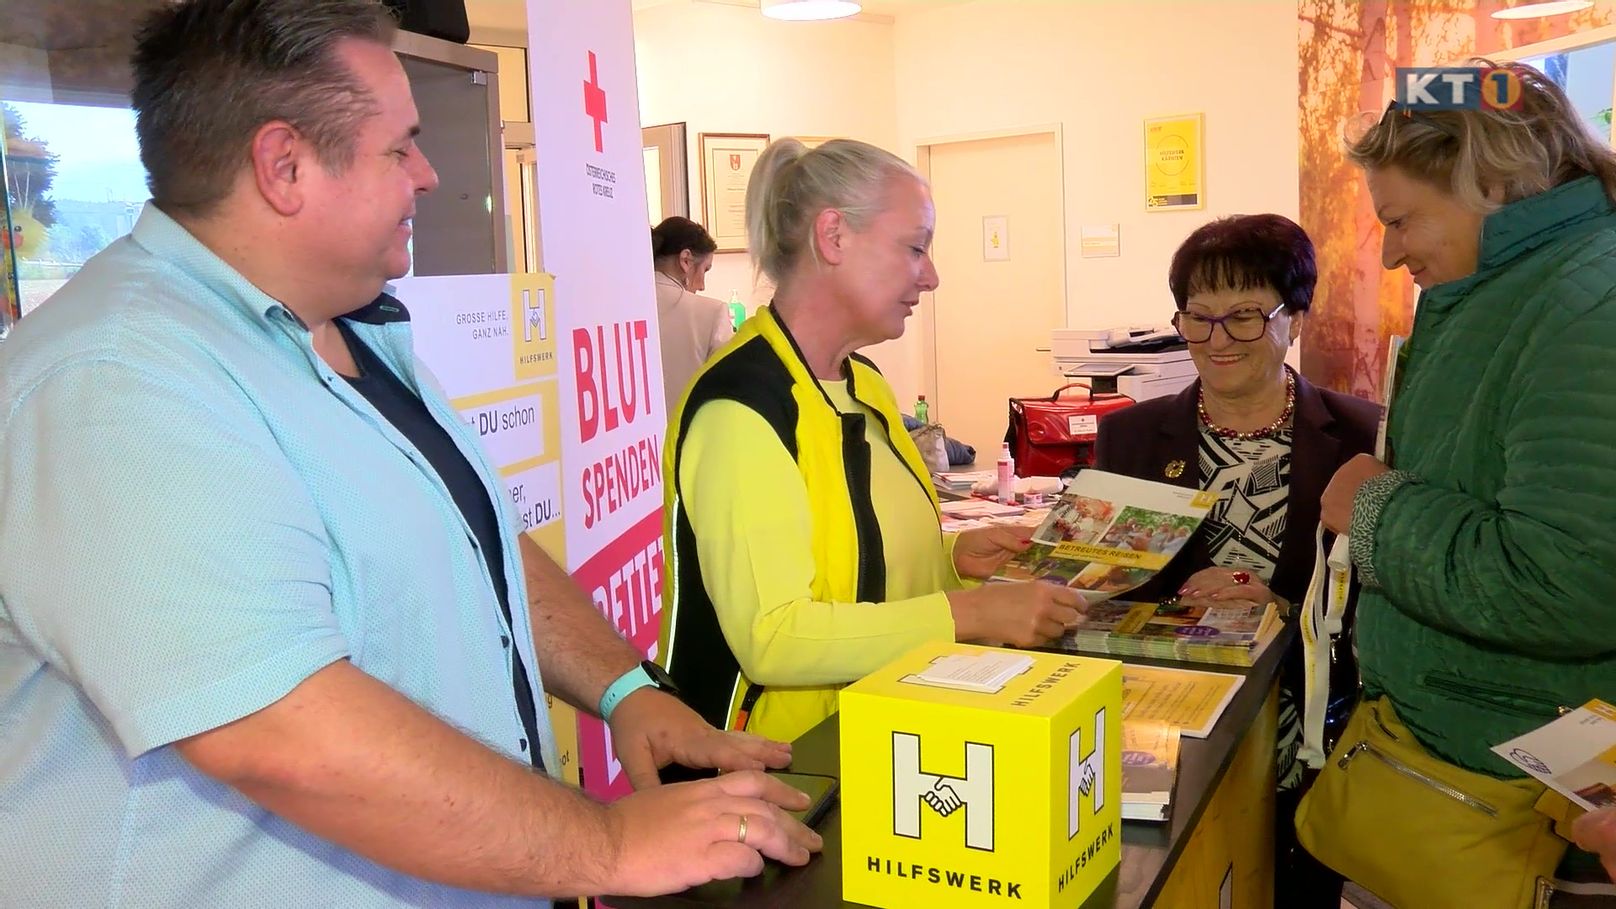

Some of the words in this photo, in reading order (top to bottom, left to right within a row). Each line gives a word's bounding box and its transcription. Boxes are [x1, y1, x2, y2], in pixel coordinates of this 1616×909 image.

[456, 312, 485, 325] GROSSE
[473, 328, 492, 340] GANZ
[520, 351, 553, 364] HILFSWERK
[573, 320, 651, 443] BLUT
[479, 410, 498, 435] DU
[502, 405, 535, 430] schon
[582, 434, 661, 529] SPENDEN
[1058, 544, 1108, 556] BETREUTES
[1011, 662, 1080, 707] HILFSWERK
[1058, 823, 1114, 893] HILFSWERK
[867, 856, 1022, 899] HILFSWERK
